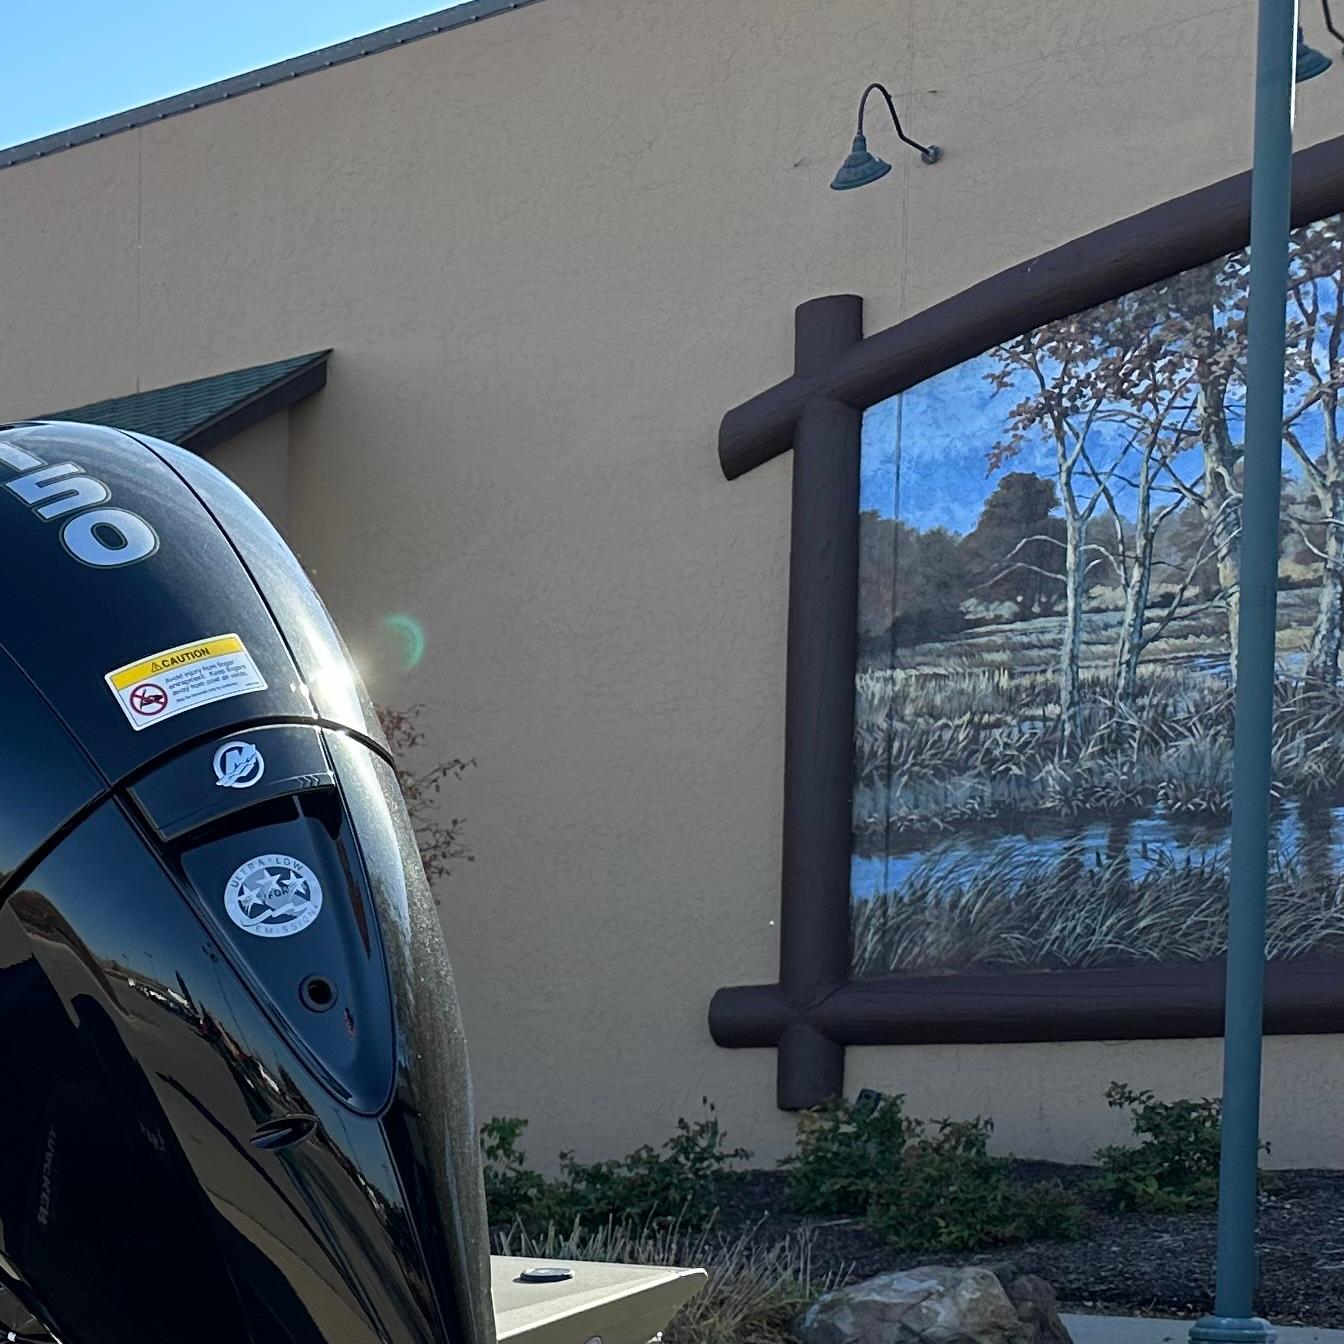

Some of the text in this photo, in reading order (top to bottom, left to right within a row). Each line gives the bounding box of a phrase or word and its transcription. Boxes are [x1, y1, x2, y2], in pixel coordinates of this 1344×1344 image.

[161, 647, 211, 668] CAUTION
[230, 856, 303, 888] ULTRA LOW
